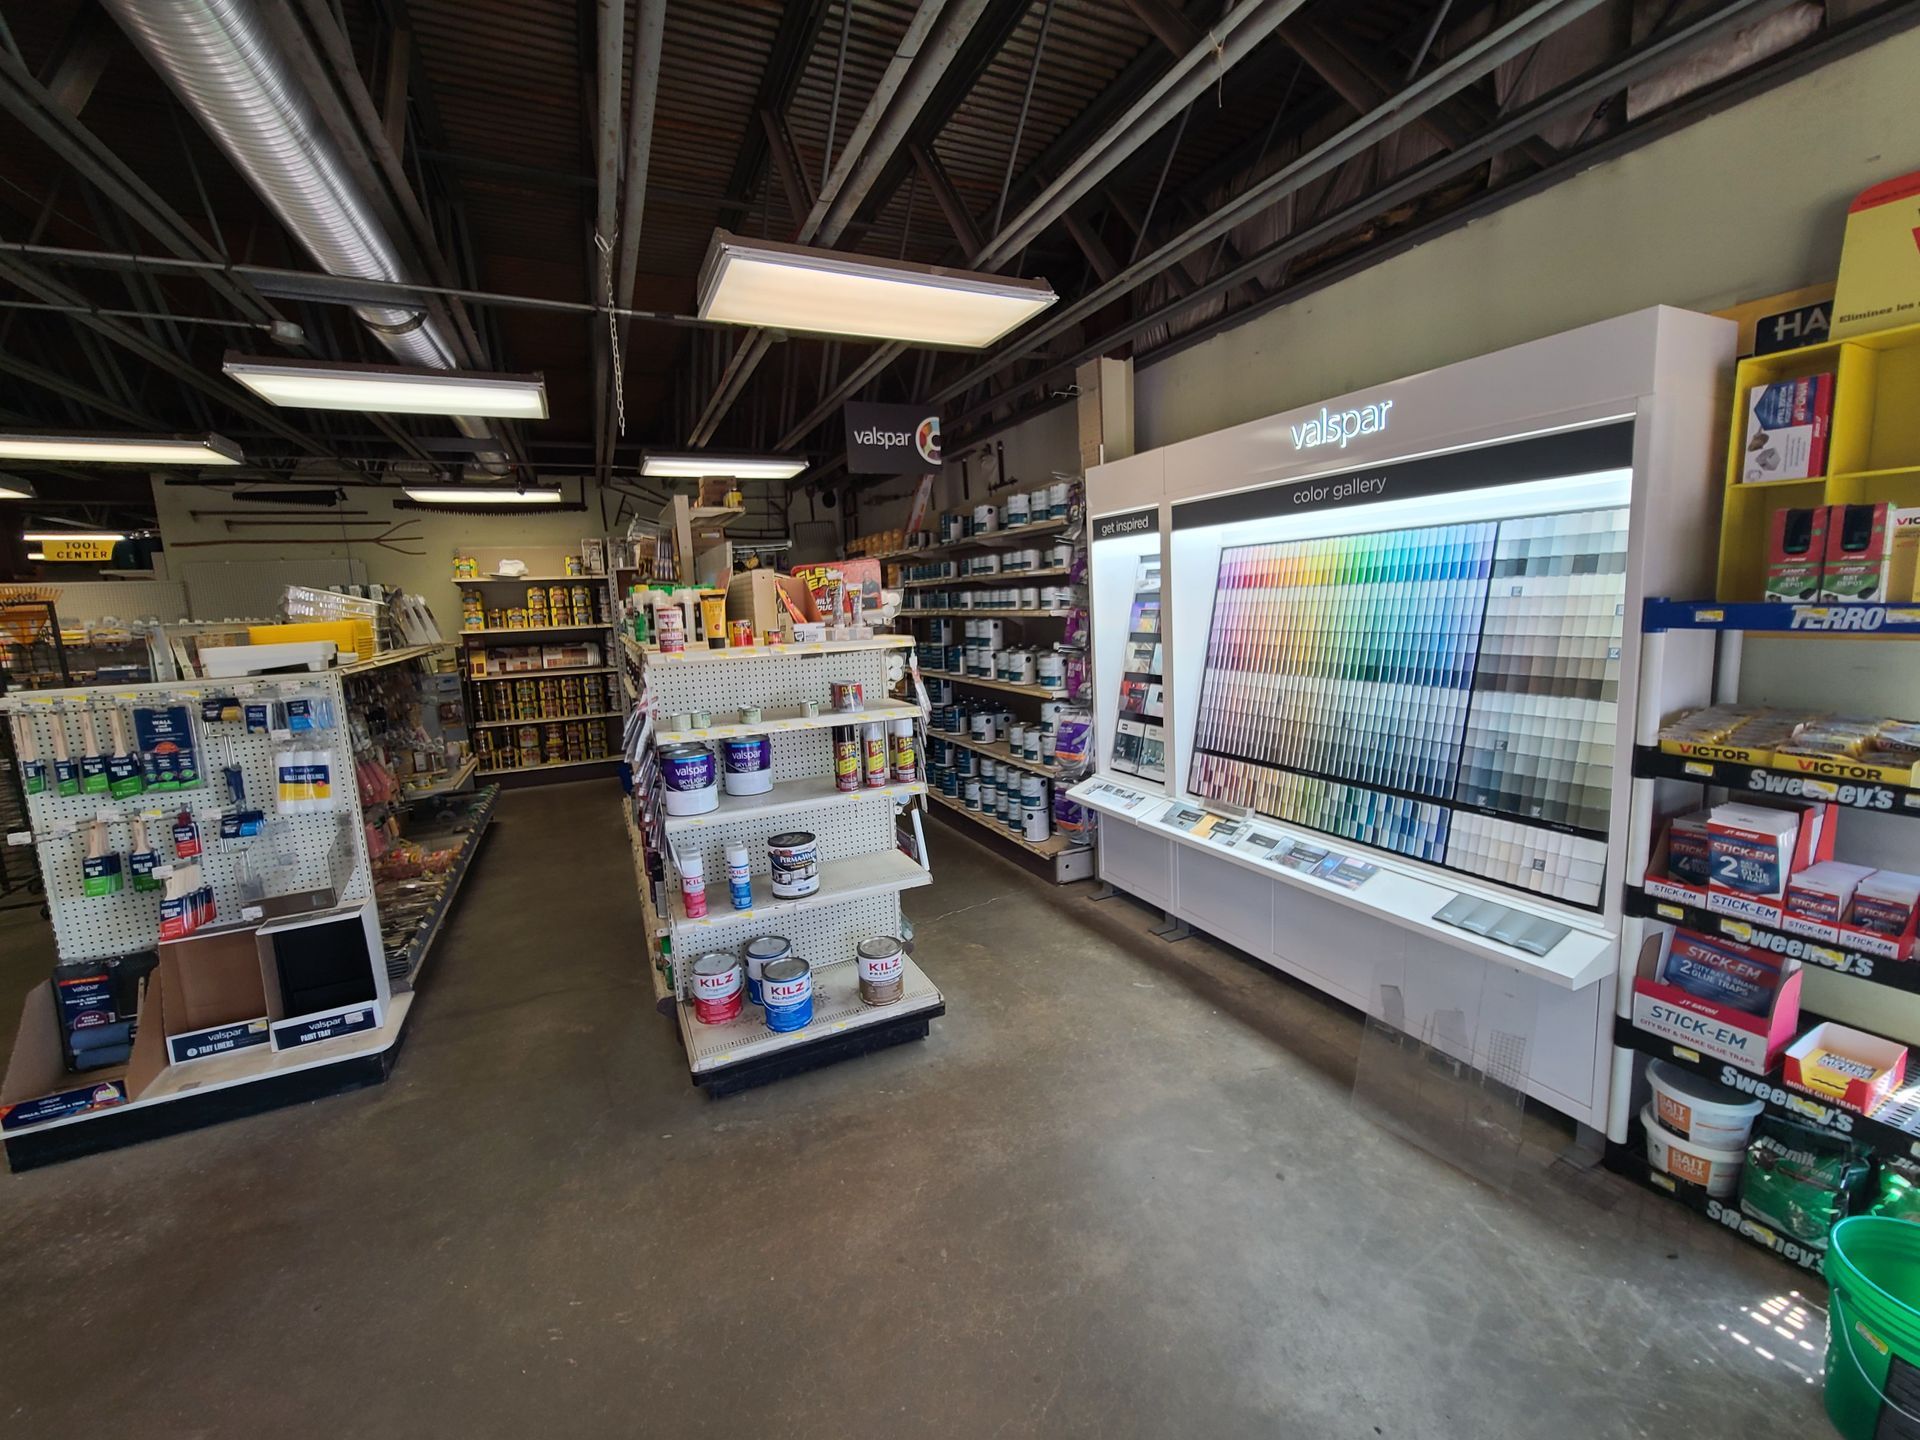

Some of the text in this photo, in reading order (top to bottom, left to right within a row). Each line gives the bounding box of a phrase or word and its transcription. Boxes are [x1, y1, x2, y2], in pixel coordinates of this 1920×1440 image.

[1291, 400, 1393, 450] valspar
[853, 426, 911, 450] valspar
[1293, 477, 1387, 505] color gallery
[1101, 515, 1149, 537] get inspired
[65, 542, 99, 550] TOOL
[56, 551, 107, 559] CENTER
[1791, 604, 1885, 631] TERRO
[732, 749, 761, 760] valspar
[1680, 743, 1750, 762] VICTOR
[675, 764, 708, 777] valspar
[1797, 759, 1882, 780] VICTOR
[1711, 842, 1776, 862] STICK-EM
[731, 867, 748, 875] KILZ
[1719, 855, 1739, 879] 2
[1654, 884, 1697, 901] STICK-EM
[1712, 894, 1778, 919] STICK-EM
[1791, 897, 1836, 914] STICK-EM
[1858, 906, 1906, 922] STICK-EM
[1788, 921, 1832, 936] STICK-EM
[1845, 935, 1893, 952] STICK-EM
[869, 958, 899, 972] KILZ
[1680, 959, 1693, 975] 2
[1688, 945, 1762, 980] STICK-EM
[72, 984, 100, 993] valspar
[700, 973, 734, 988] KILZ
[771, 982, 804, 996] KILZ
[1691, 969, 1749, 996] GLUE TRAPS
[309, 1017, 342, 1030] valspar
[1651, 1005, 1748, 1050] STICK-EM
[208, 1028, 243, 1041] valspar
[300, 1029, 332, 1043] PAINT TRAY
[1640, 1017, 1657, 1028] CITY
[1657, 1023, 1671, 1034] RAT
[1680, 1032, 1705, 1047] SNAKE
[1706, 1042, 1728, 1056] GLUE
[1729, 1051, 1756, 1067] TRAPS
[199, 1039, 235, 1055] TRAY LINERS
[1786, 1080, 1862, 1114] MOUSE GLUE TRAPS
[1672, 1148, 1705, 1170] BAIT
